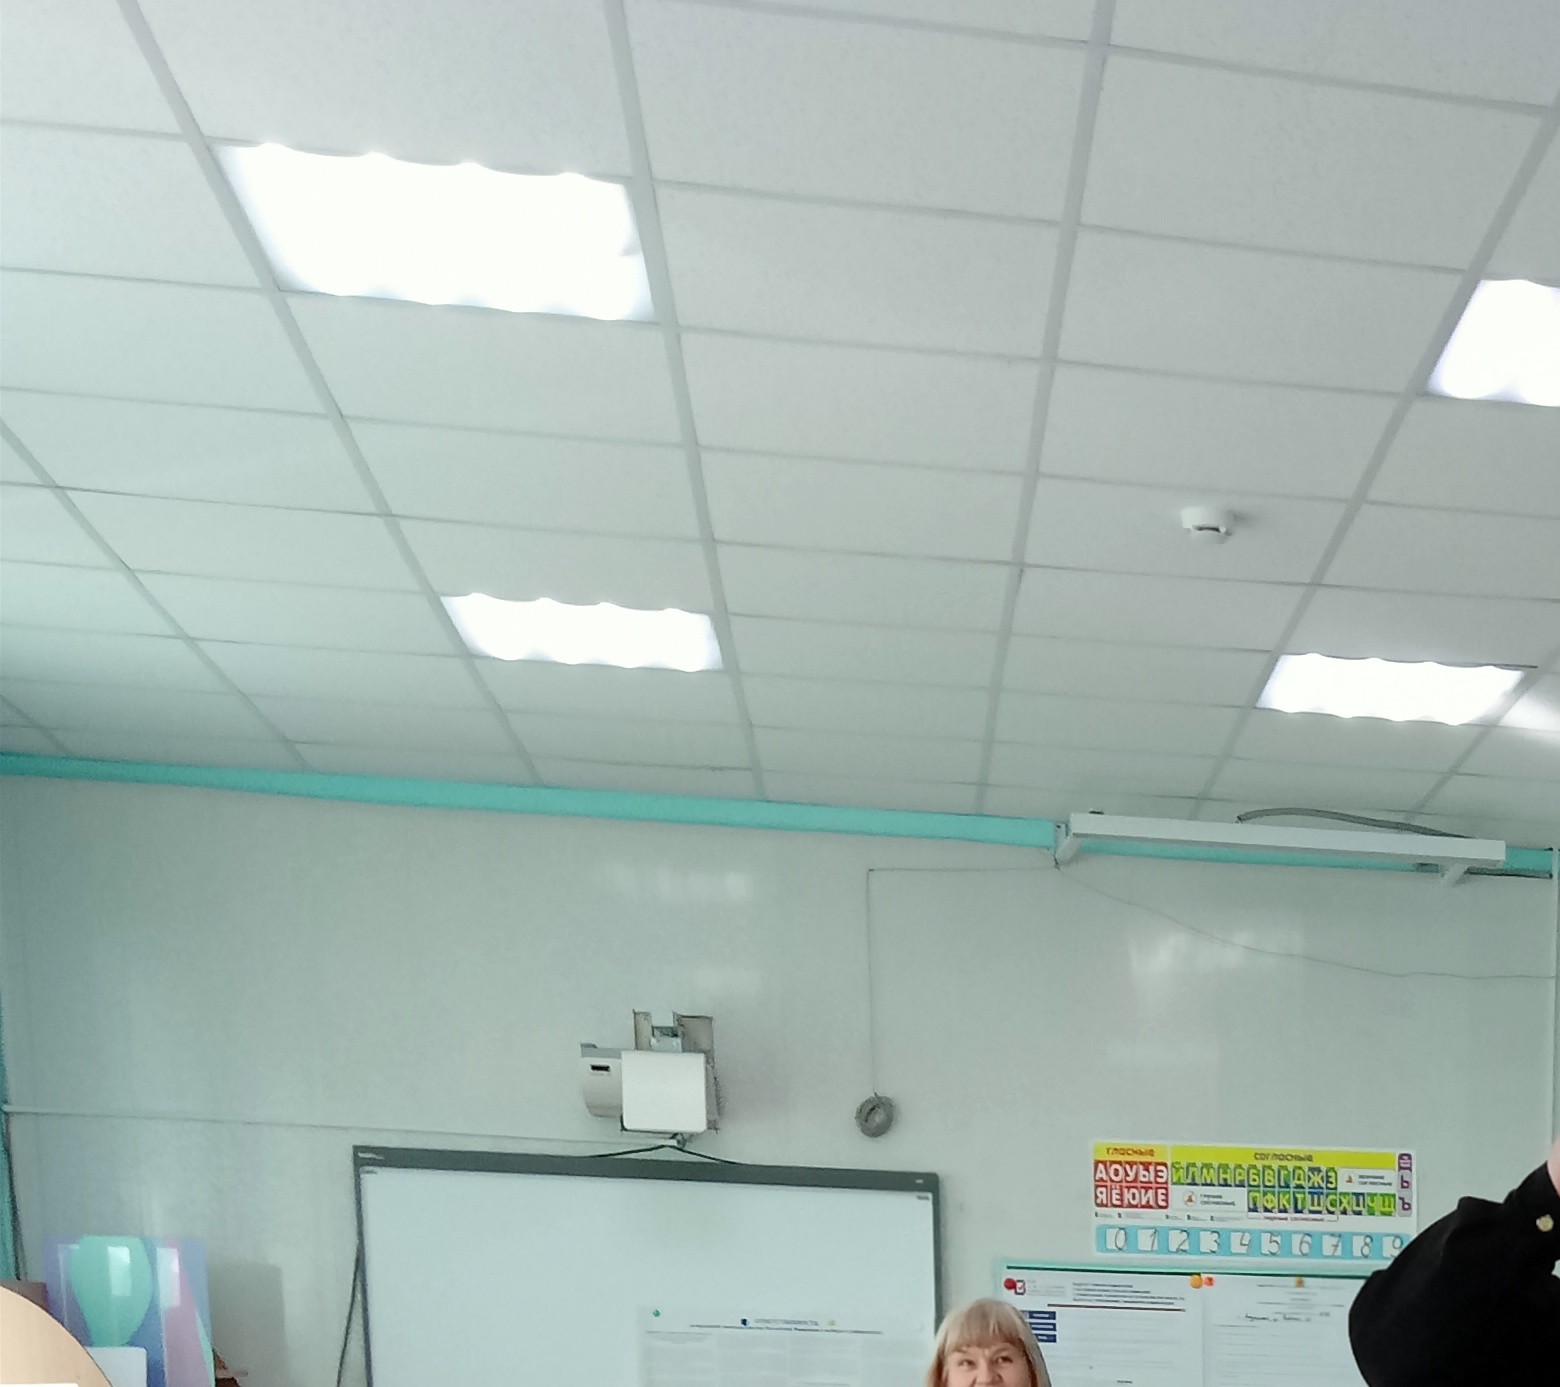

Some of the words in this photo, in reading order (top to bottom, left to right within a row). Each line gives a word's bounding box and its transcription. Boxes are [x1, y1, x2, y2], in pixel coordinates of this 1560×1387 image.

[1115, 1227, 1127, 1251] 0
[1176, 1229, 1190, 1253] 2
[1209, 1230, 1221, 1254] 3
[1240, 1232, 1251, 1254] 4
[1268, 1232, 1281, 1256] 5
[1299, 1233, 1312, 1256] 6
[1330, 1234, 1342, 1256] 7
[1361, 1235, 1373, 1258] 8
